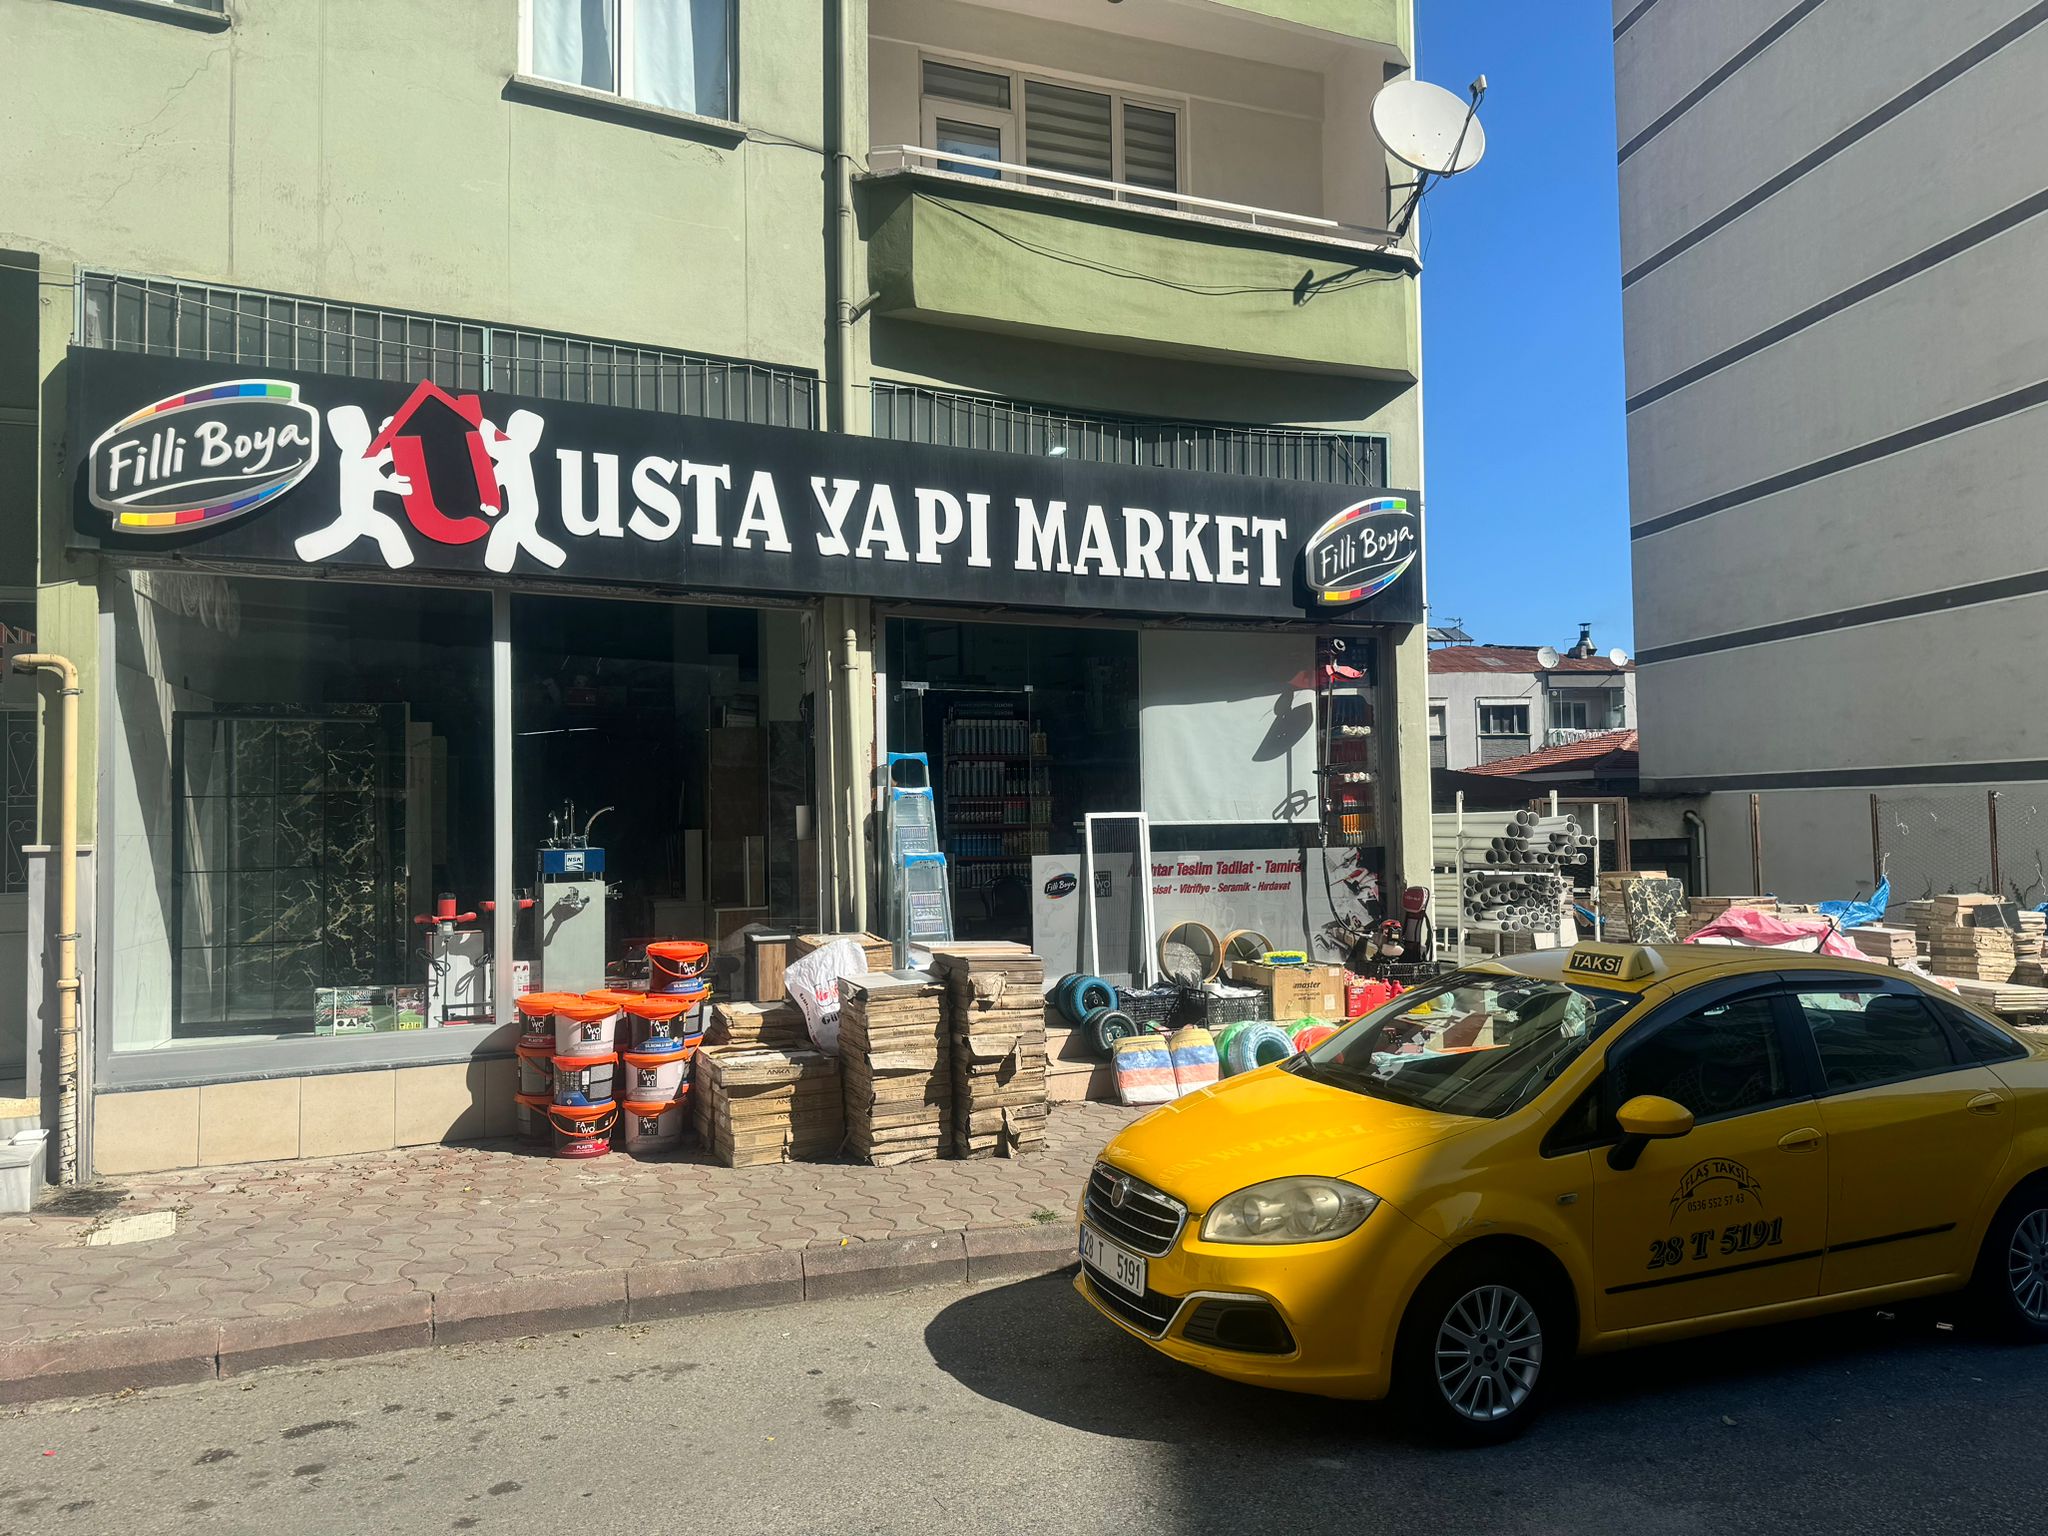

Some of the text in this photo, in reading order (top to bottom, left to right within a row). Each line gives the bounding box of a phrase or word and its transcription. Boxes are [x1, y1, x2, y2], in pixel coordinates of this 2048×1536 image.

[109, 421, 310, 492] Filli Boya
[556, 448, 1287, 586] USTA YAPI MARKET
[1320, 525, 1414, 580] Filli Boya
[1046, 882, 1058, 892] Filli
[1177, 862, 1213, 876] Teslim
[1216, 860, 1254, 874] Tadilat
[1218, 882, 1250, 892] Seramik
[1688, 1200, 1706, 1212] 0536
[1724, 1195, 1734, 1206] 57
[1084, 1230, 1140, 1289] 28 T 5191
[1647, 1216, 1782, 1270] 28 T 5191
